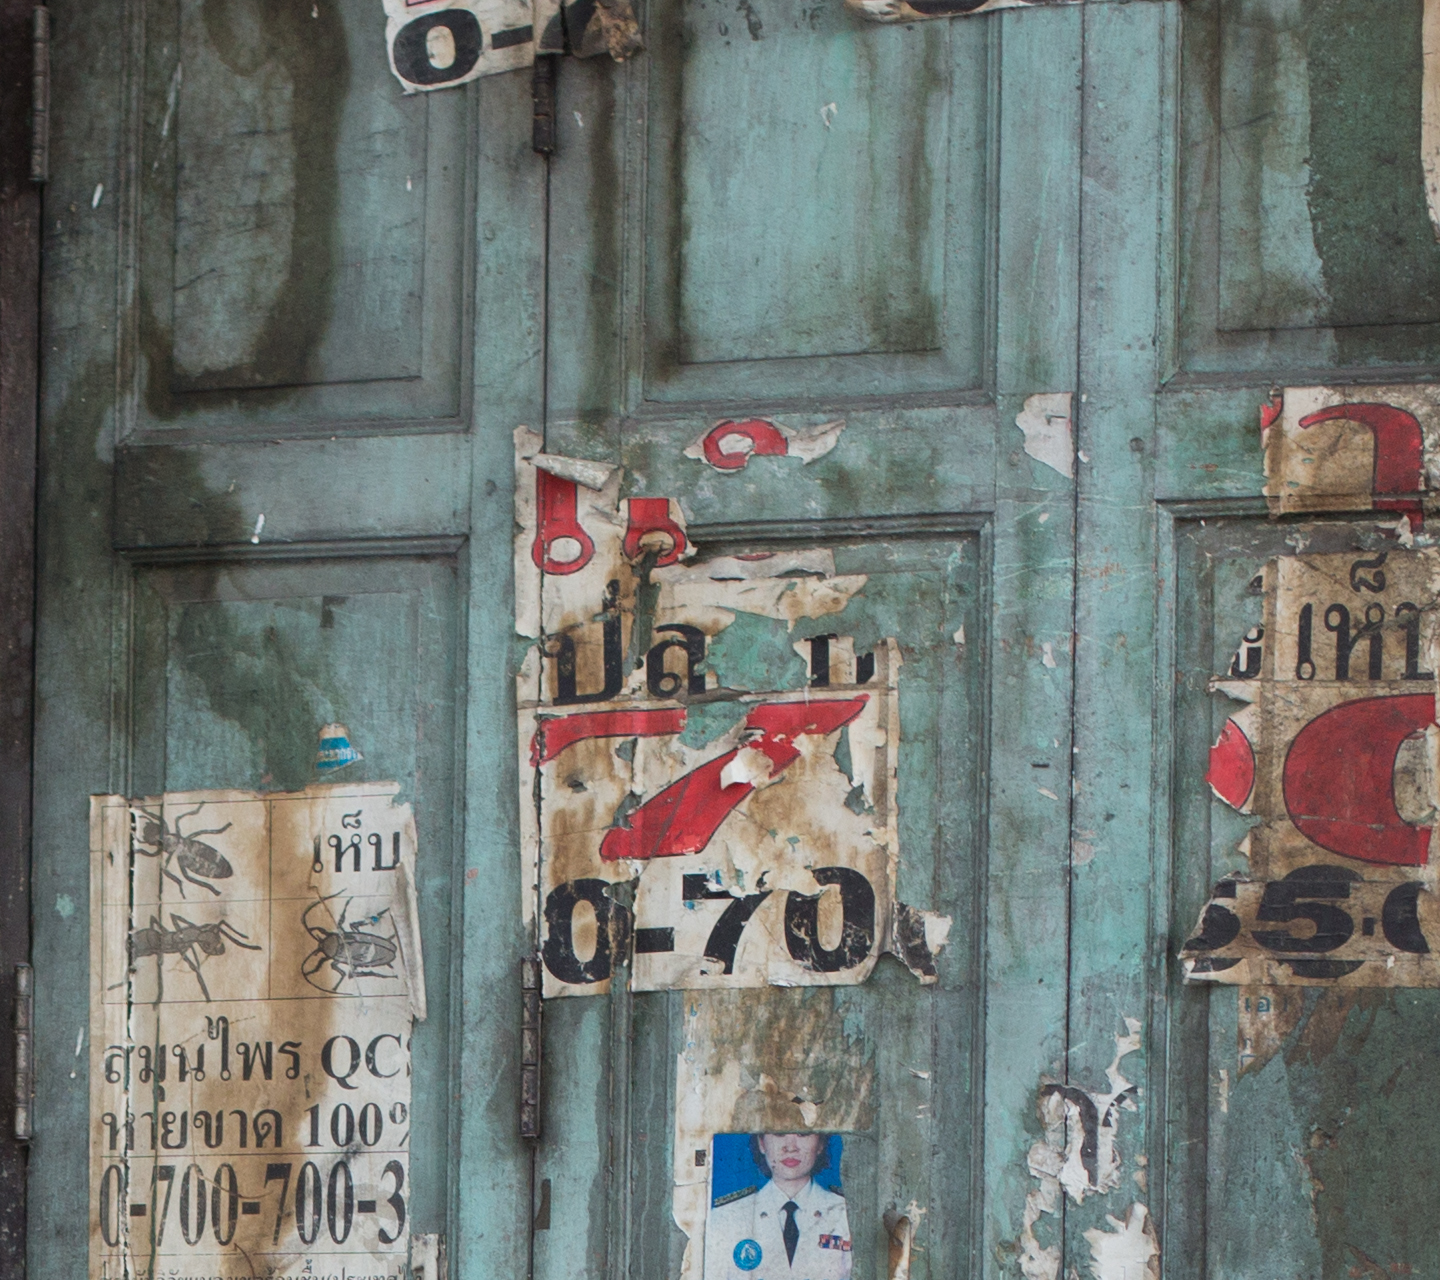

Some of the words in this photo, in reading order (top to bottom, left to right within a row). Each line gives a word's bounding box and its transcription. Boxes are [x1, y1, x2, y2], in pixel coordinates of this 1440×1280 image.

[313, 812, 402, 873] เห็บ
[104, 1015, 302, 1102] สมุนไพร
[102, 1106, 282, 1150] หายขาด
